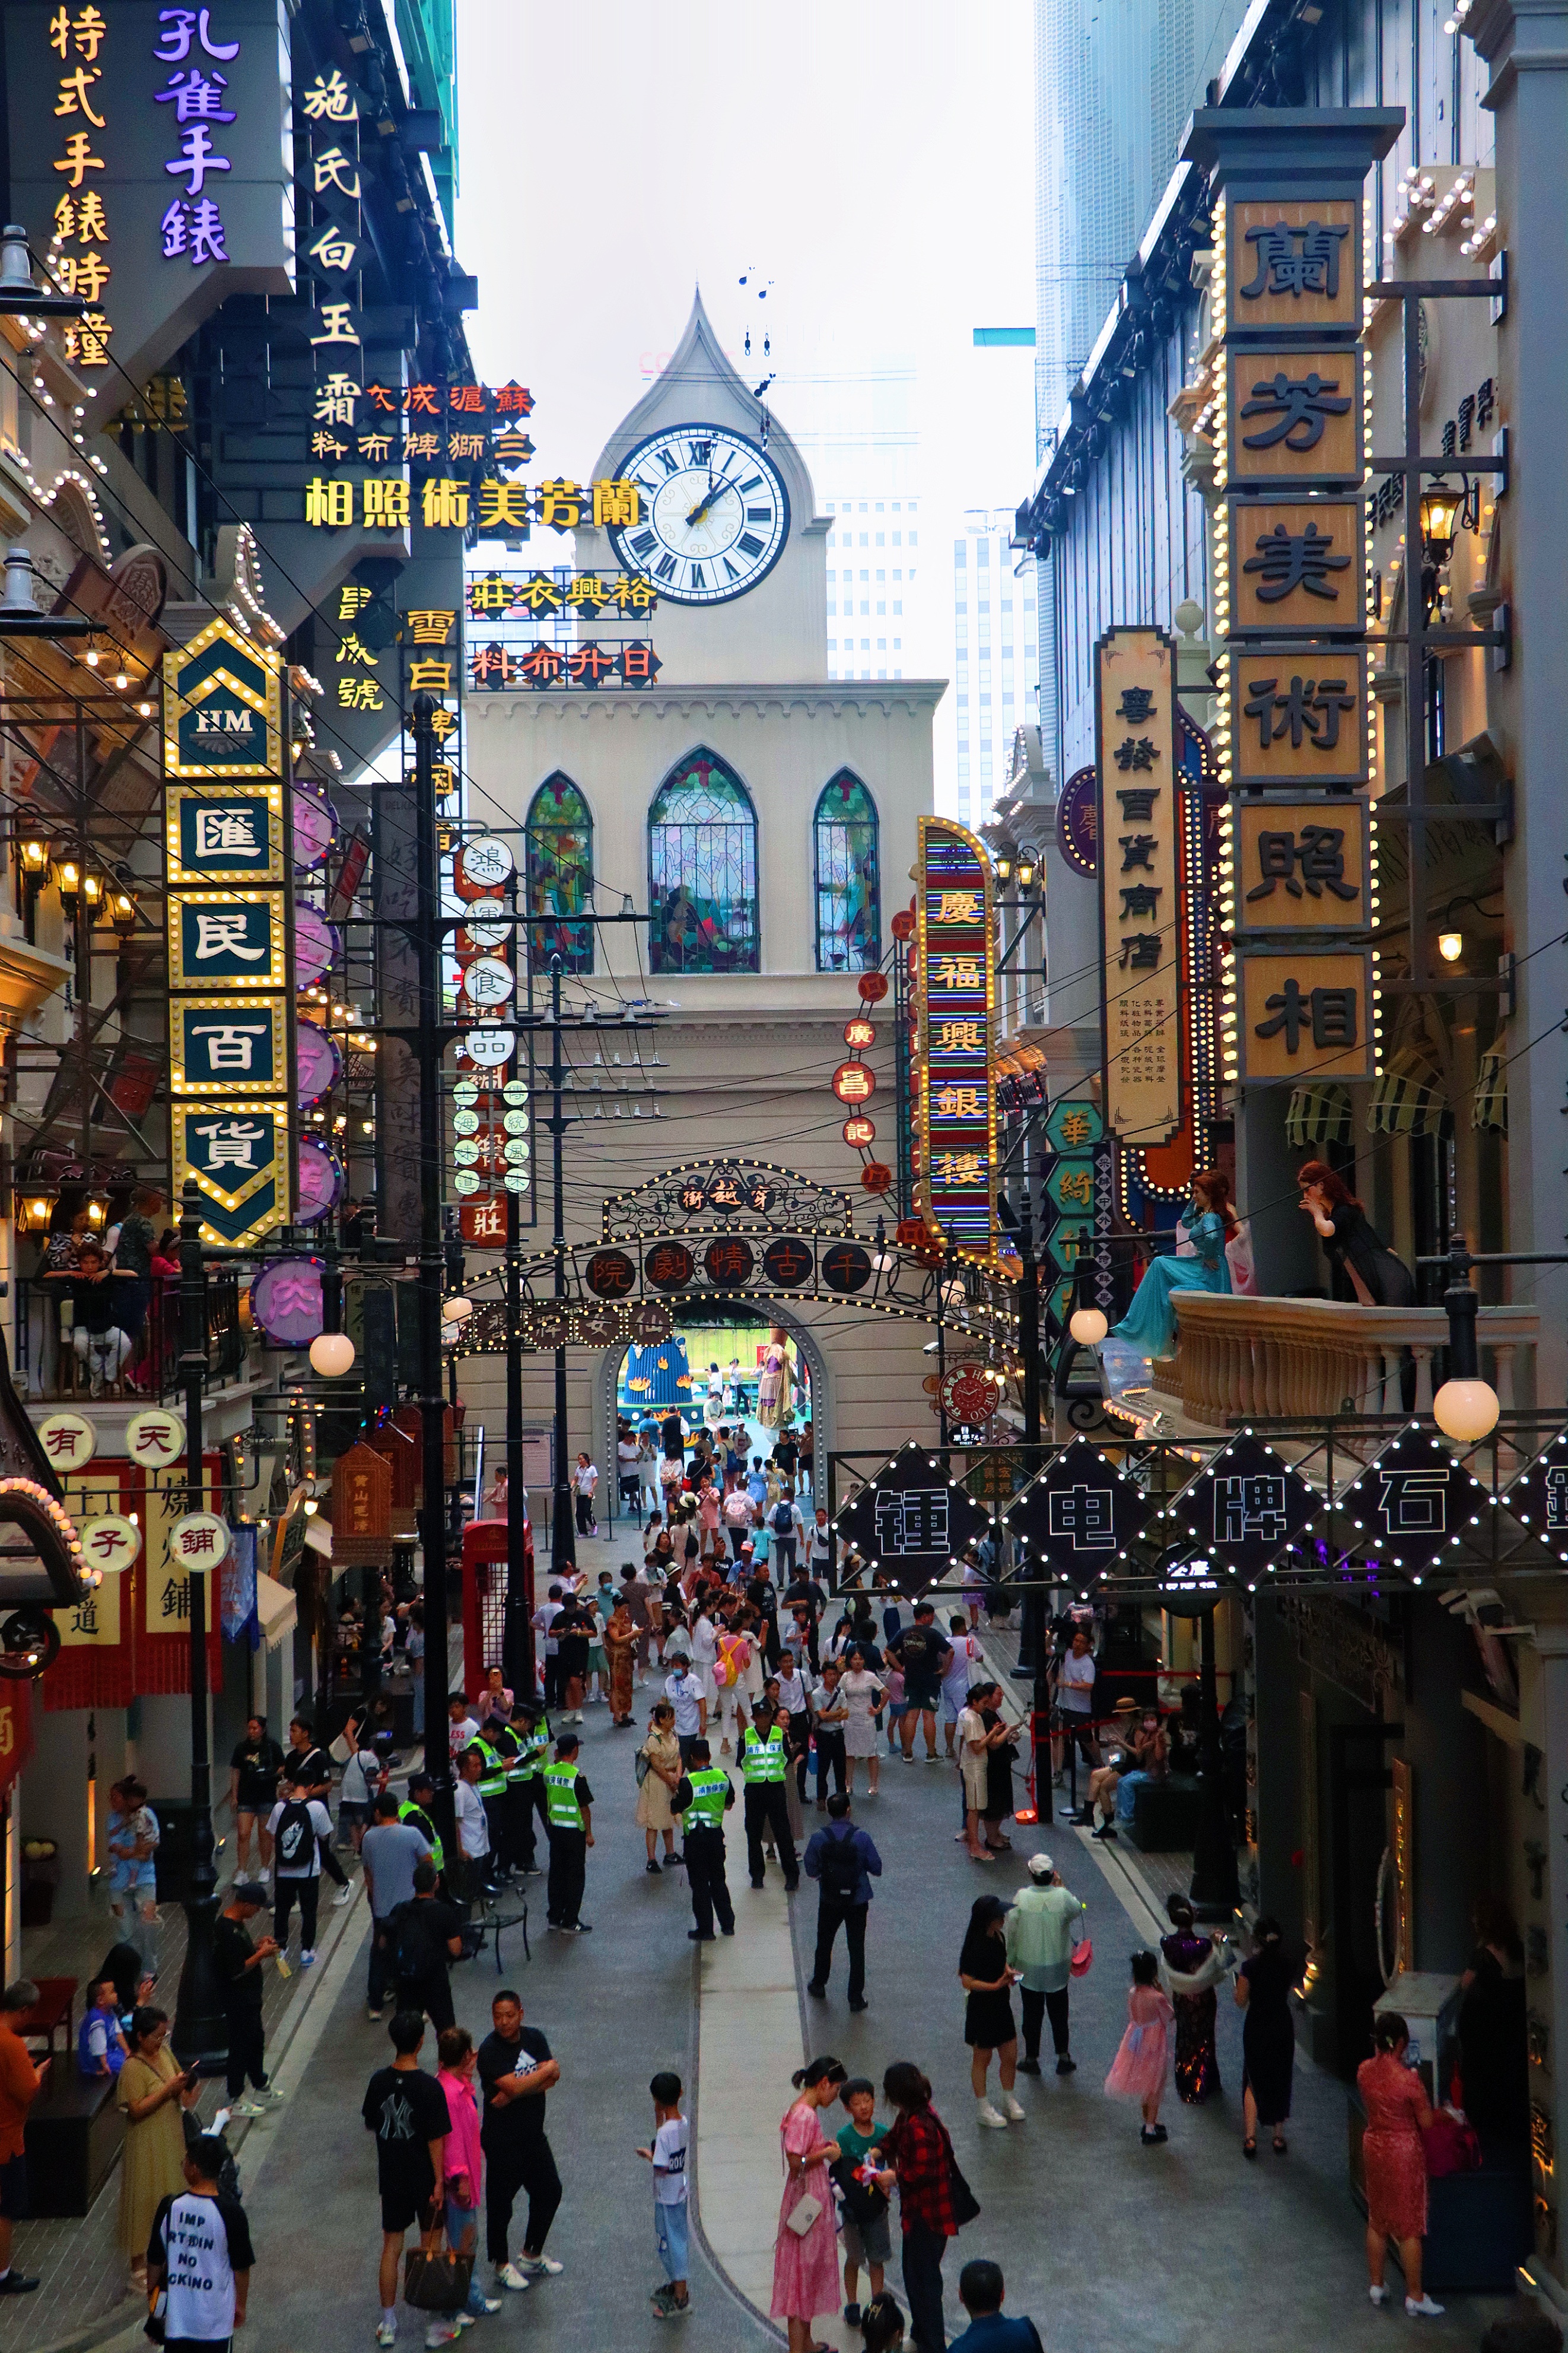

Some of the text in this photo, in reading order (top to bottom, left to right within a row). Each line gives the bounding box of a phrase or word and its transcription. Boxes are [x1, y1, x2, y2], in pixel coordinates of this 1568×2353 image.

[153, 8, 239, 265] 孔雀手錶
[303, 71, 362, 427] 施氏白玉霜
[196, 710, 253, 732] HM
[1240, 220, 1362, 1055] 蘭芳美術照相
[191, 808, 267, 1170] 匯民百貨
[470, 846, 505, 1053] 鴻運食品
[934, 893, 983, 1186] 慶福興銀樓
[457, 1086, 476, 1190] 上海味道
[838, 1023, 873, 1140] 廣昌記
